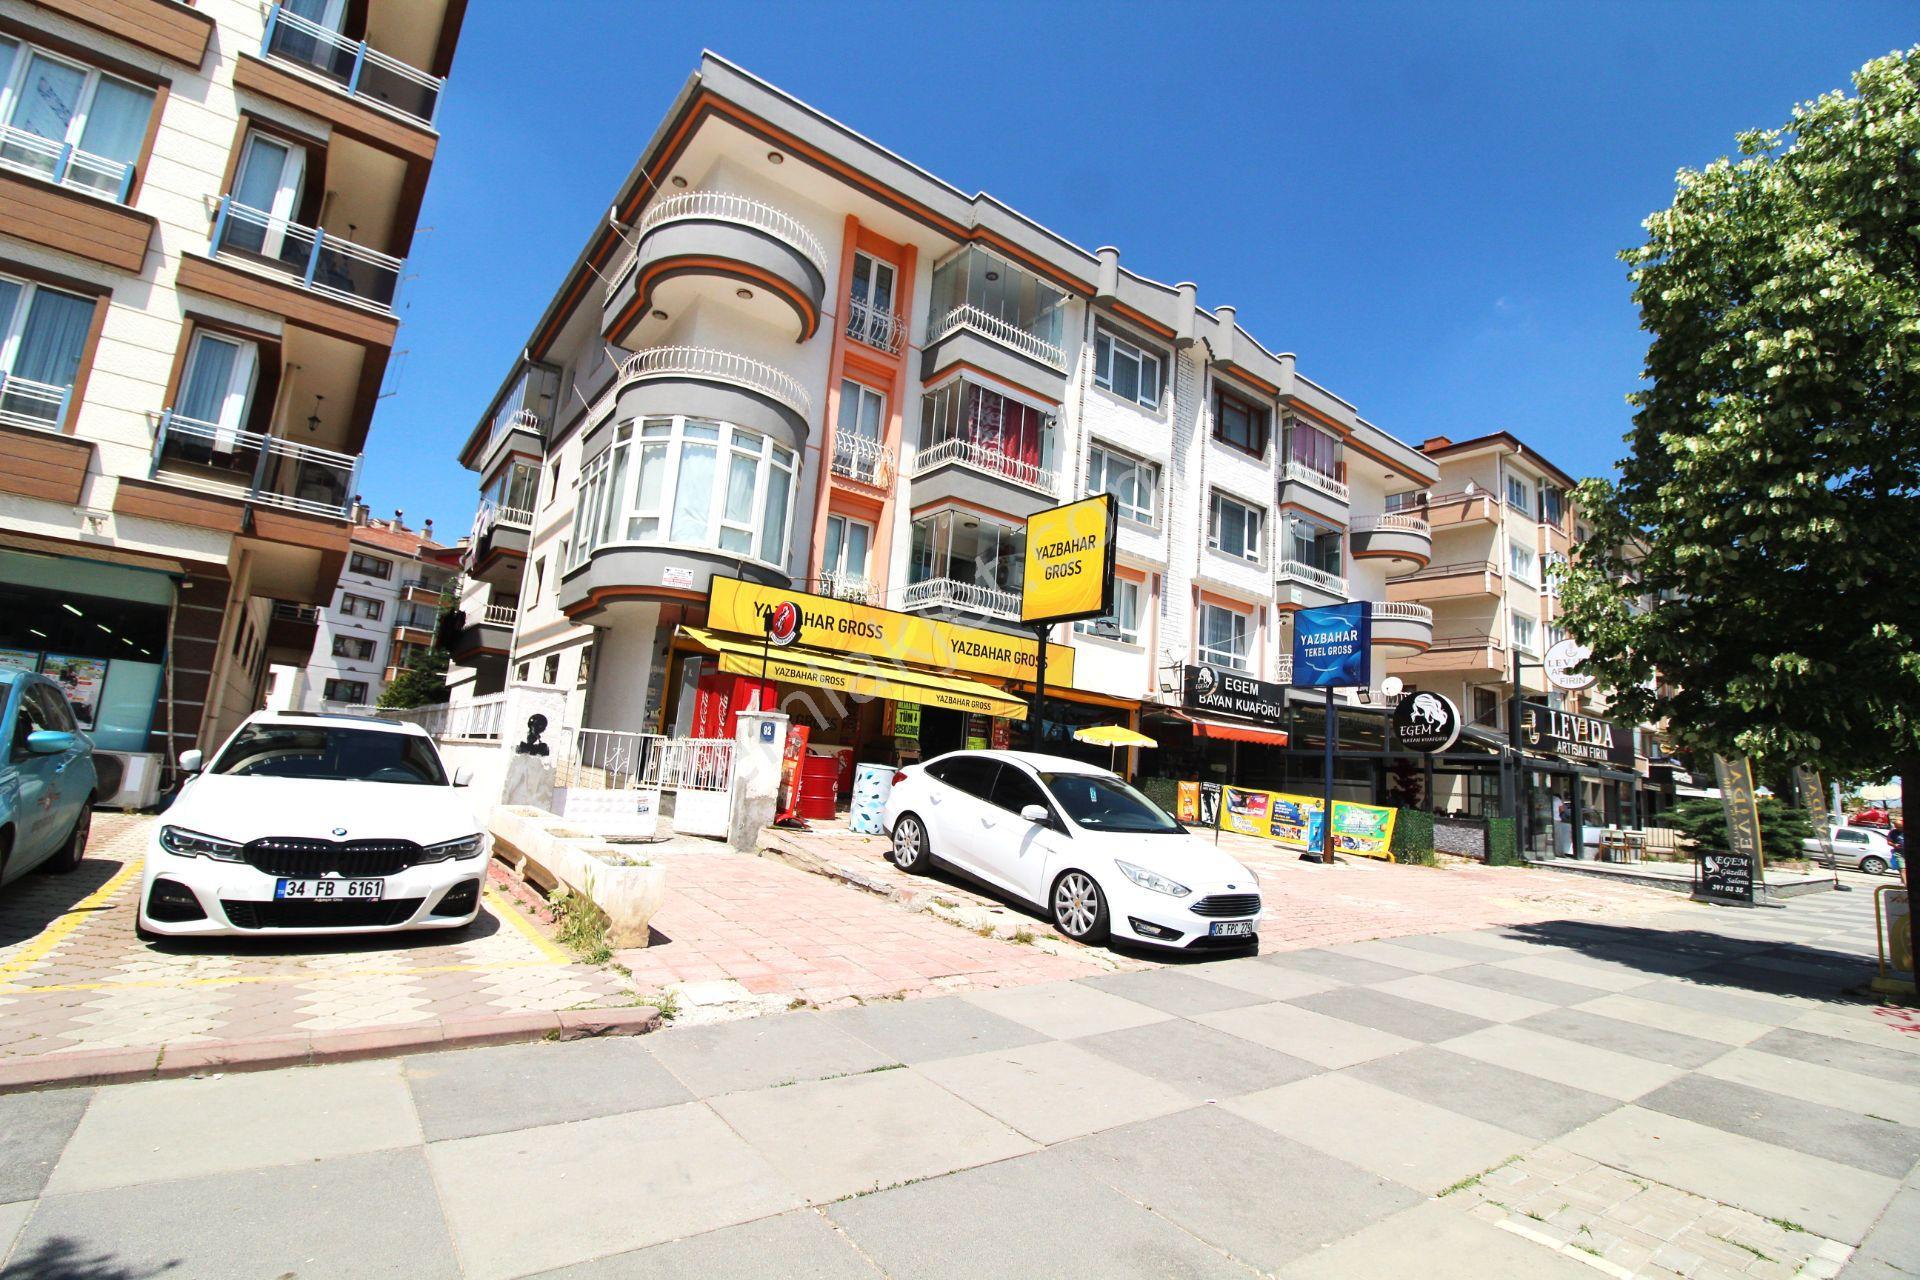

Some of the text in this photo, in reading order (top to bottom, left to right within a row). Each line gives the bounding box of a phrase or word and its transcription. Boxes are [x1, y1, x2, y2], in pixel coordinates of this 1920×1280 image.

[1035, 534, 1096, 561] YAZBAHAR
[1045, 559, 1082, 580] GROSS
[754, 601, 884, 640] YAHAR GROSS
[1300, 630, 1358, 646] YAZBAHAR
[950, 639, 1011, 663] YAZBAHAR
[1304, 644, 1353, 658] TEKEL GROSS
[774, 666, 846, 687] YAZBAHAR GROSS
[1225, 677, 1259, 696] EGEM
[936, 694, 992, 711] YAZBAHAR GROSS
[1199, 694, 1281, 718] BAYAN KUAFÖRÜ
[763, 725, 772, 736] 92
[1400, 724, 1432, 736] EGEM
[1715, 856, 1748, 867] EGEM
[286, 881, 306, 897] 34
[315, 881, 335, 897] FB
[348, 881, 380, 897] 6161
[1215, 923, 1224, 935] 06
